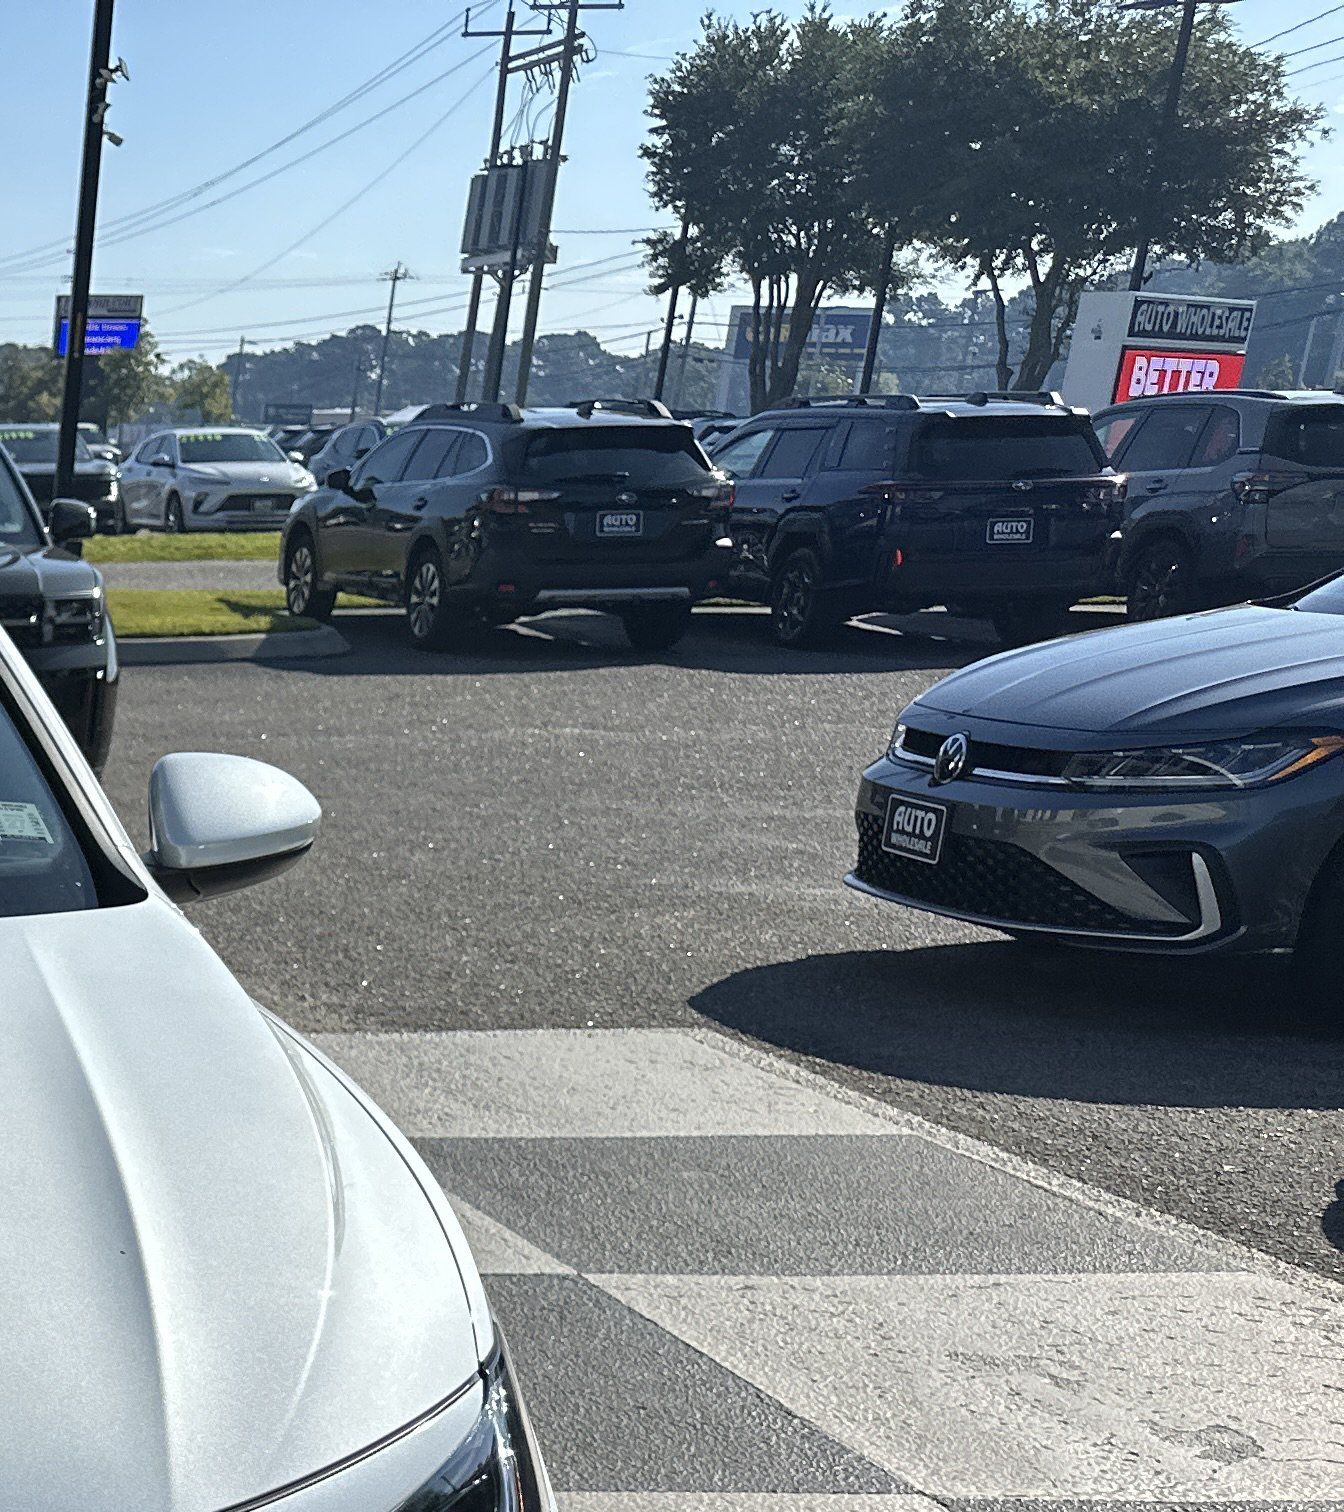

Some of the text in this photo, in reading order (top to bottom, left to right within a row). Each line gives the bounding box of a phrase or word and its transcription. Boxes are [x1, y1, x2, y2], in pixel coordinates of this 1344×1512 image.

[1134, 303, 1251, 339] AUTO WHOLESALE
[1128, 355, 1220, 398] BETTER
[603, 514, 637, 526] AUTO
[993, 521, 1027, 533] AUTO
[893, 805, 937, 838] AUTO
